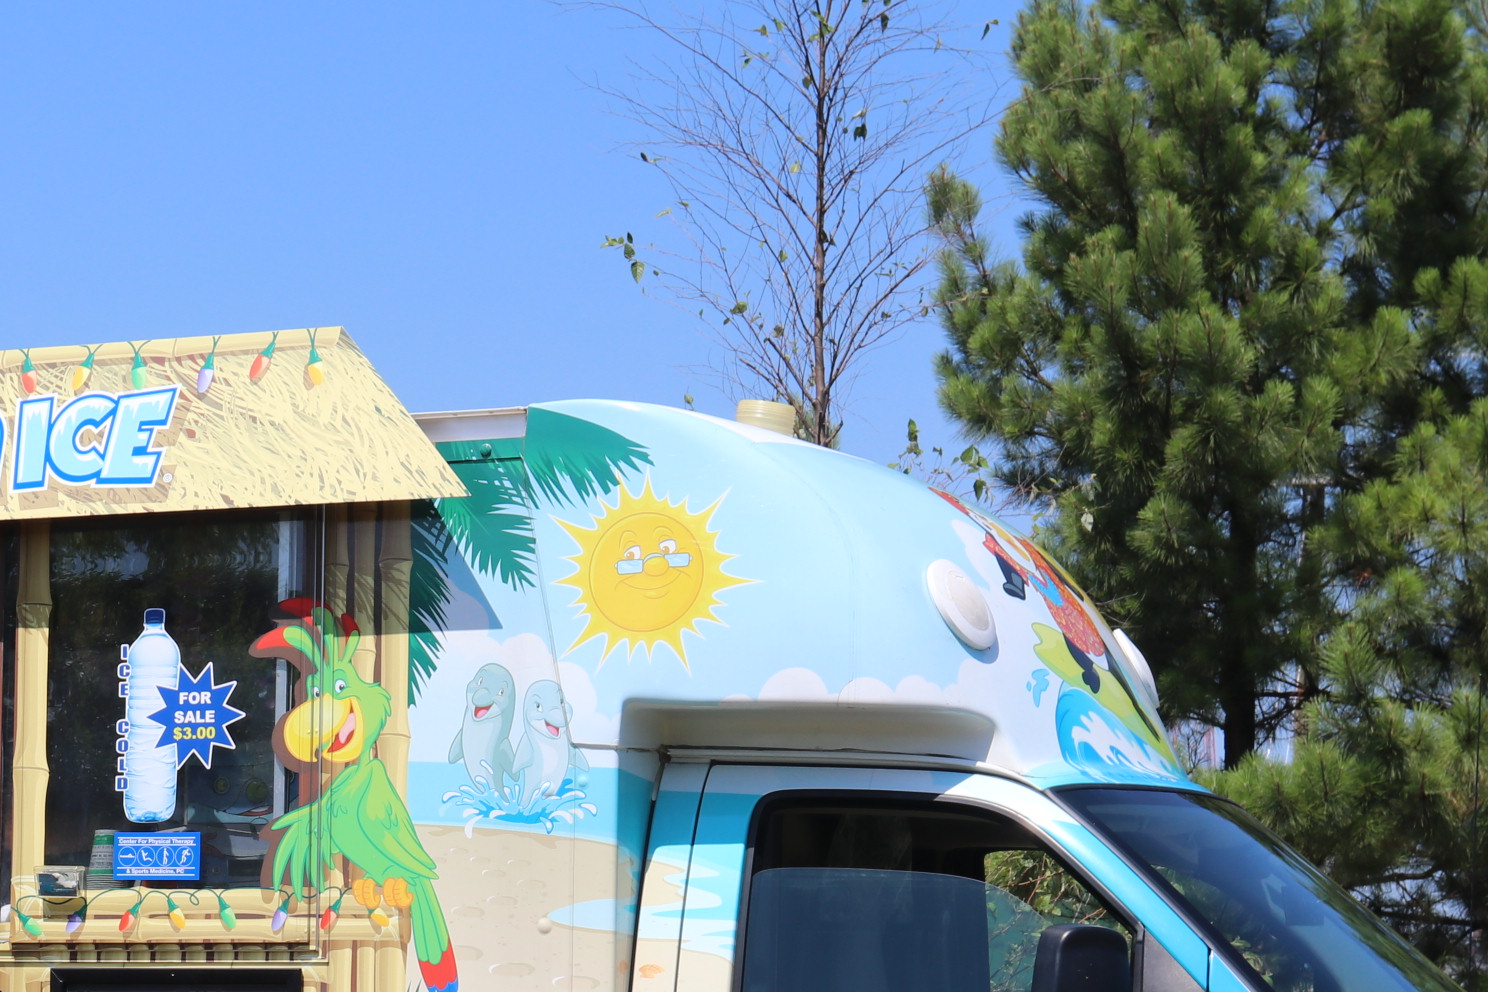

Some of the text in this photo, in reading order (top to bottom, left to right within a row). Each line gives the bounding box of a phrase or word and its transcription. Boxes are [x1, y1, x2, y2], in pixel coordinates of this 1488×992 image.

[10, 384, 182, 494] ICE
[117, 644, 131, 697] ICE
[179, 691, 211, 705] FOR
[173, 726, 216, 740] $3.00
[174, 710, 215, 724] SALE
[115, 720, 130, 791] COLD
